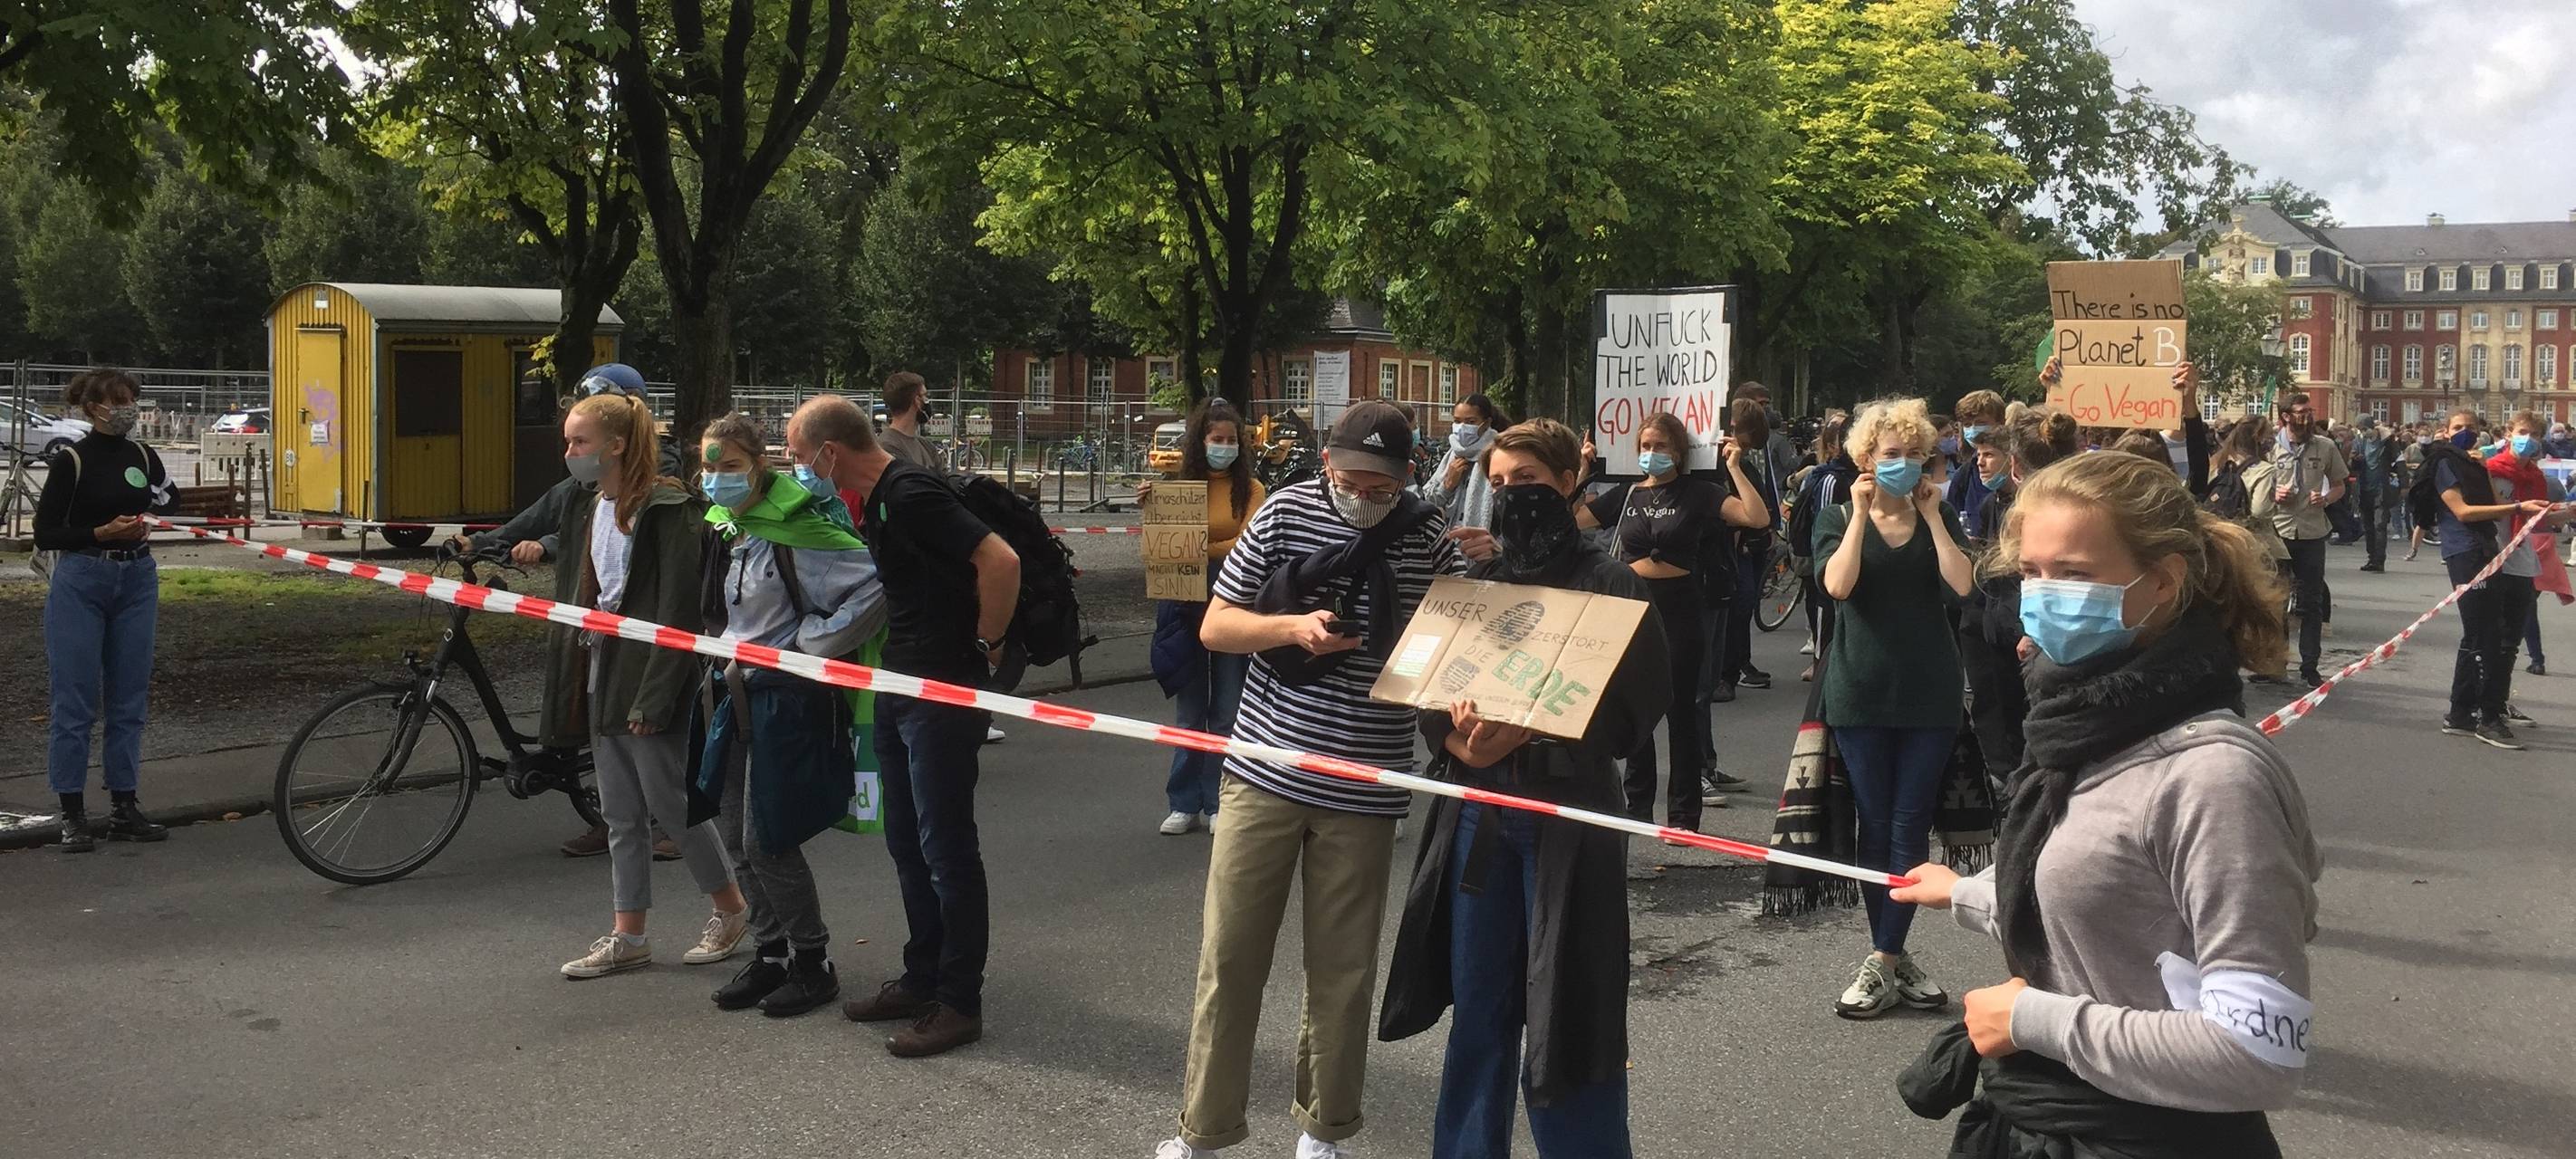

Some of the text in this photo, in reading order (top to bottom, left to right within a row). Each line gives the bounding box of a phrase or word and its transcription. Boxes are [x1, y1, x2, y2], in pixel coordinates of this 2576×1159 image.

[2052, 290, 2185, 320] There is no
[1611, 309, 1711, 349] UNFUCK
[2059, 326, 2181, 367] Planet B
[1598, 350, 1718, 388] THE WORLD
[1597, 398, 1632, 445] GO
[2070, 384, 2100, 422] Go
[2105, 384, 2177, 425] Vegan
[1643, 506, 1676, 519] Vegan
[1145, 531, 1207, 560] VEGAN?
[1177, 565, 1200, 576] KEIN
[1423, 599, 1487, 622] UNSER
[1465, 644, 1493, 663] DIE
[1492, 649, 1591, 716] ERDE
